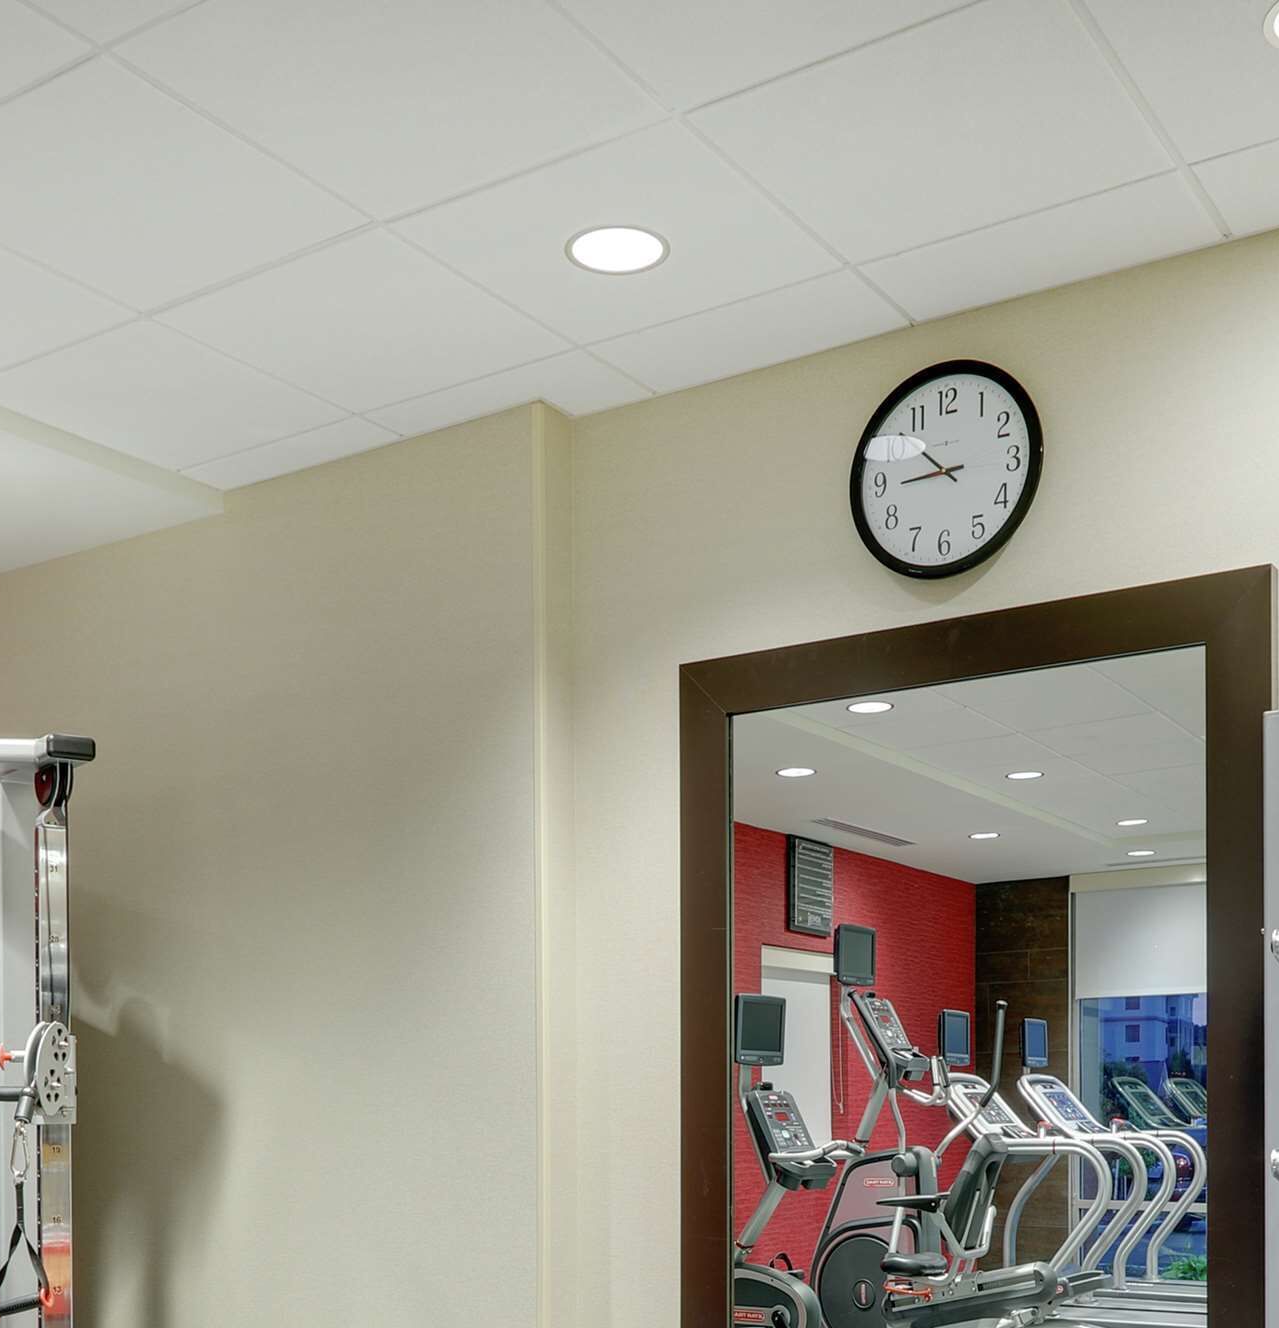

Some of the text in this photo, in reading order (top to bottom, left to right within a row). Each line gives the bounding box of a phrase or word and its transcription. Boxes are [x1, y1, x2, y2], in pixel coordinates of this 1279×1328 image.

[937, 386, 958, 416] 12
[978, 391, 985, 418] 1
[910, 404, 926, 433] 11
[996, 411, 1011, 439] 2
[1006, 444, 1021, 472] 3
[873, 472, 887, 498] 9
[993, 482, 1009, 509] 4
[885, 504, 899, 530] 8
[971, 514, 986, 540] 5
[909, 526, 922, 552] 7
[937, 529, 951, 556] 6
